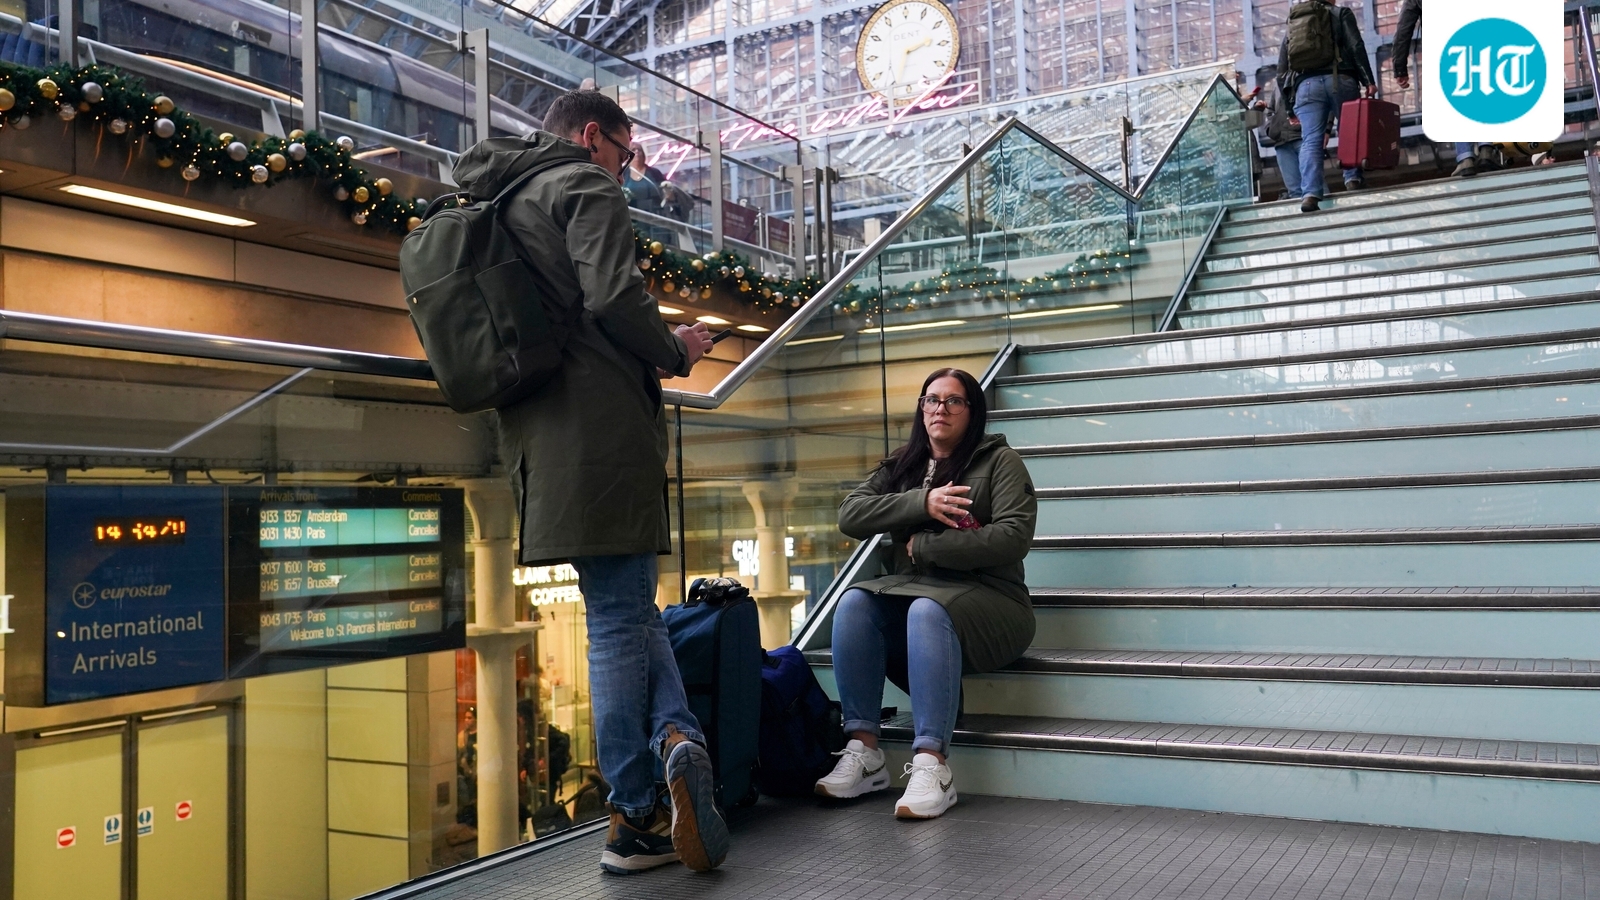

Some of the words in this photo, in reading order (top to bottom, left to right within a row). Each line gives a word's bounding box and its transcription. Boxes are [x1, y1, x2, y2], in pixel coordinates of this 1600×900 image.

[893, 30, 920, 41] DENT
[260, 490, 294, 502] Arrivals
[260, 510, 279, 523] 9133
[307, 510, 348, 523] Amsterdam
[408, 509, 438, 521] Cancelled
[260, 527, 279, 540] 9031
[306, 527, 326, 539] Paris
[408, 524, 438, 536] Cancelled
[260, 562, 280, 575] 9037
[307, 560, 326, 572] Paris
[409, 555, 439, 567] Cancelled
[101, 583, 172, 600] eurostar
[260, 579, 279, 592] 9145
[409, 571, 439, 582] Cancelled
[531, 585, 581, 607] COFFEE
[260, 614, 280, 628] 9043
[307, 610, 326, 623] Paris
[409, 601, 439, 613] Cancelled
[71, 611, 203, 642] International
[290, 628, 324, 641] Welcome
[326, 626, 334, 637] to
[336, 625, 345, 637] St
[346, 622, 375, 635] Pancras
[377, 618, 416, 632] International
[72, 646, 157, 675] Arrivals
